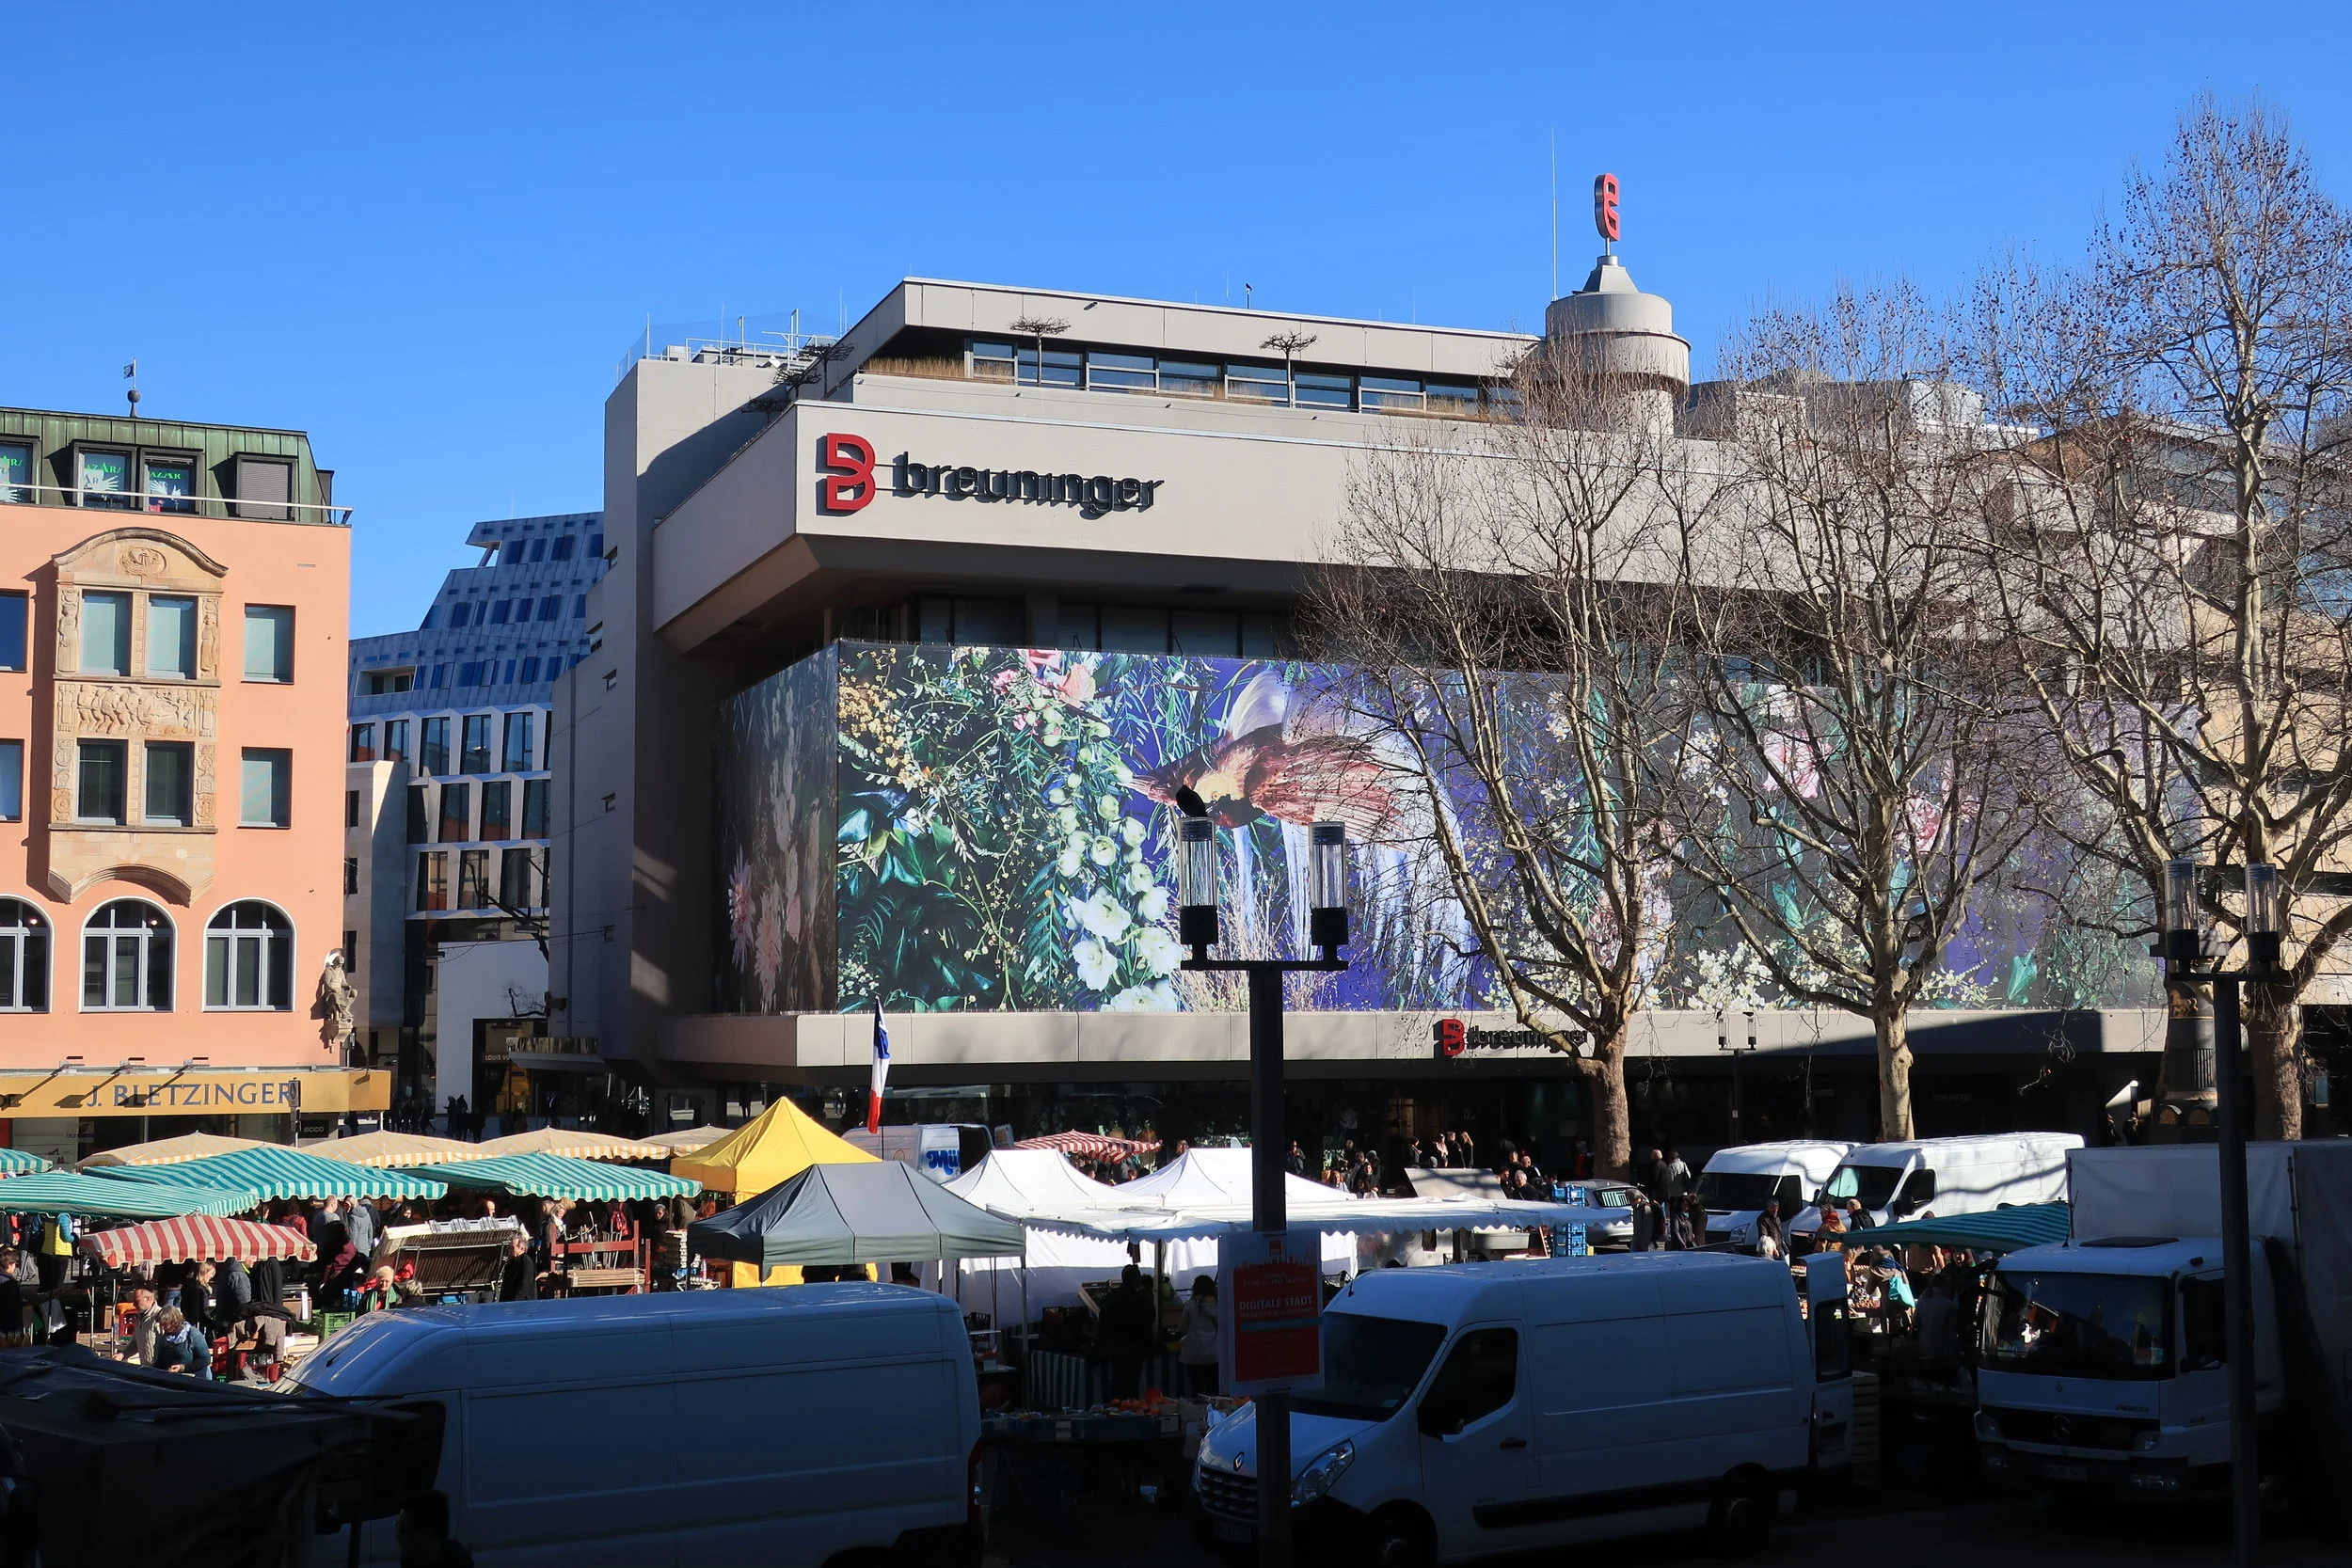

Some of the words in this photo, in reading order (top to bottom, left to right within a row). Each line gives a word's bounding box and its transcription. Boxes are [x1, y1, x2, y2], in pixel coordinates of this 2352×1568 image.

[902, 451, 1165, 515] breuninger
[87, 1085, 103, 1107] J.
[114, 1082, 292, 1107] BLETZINGER
[1239, 1298, 1281, 1311] DIGITALE
[1284, 1295, 1312, 1307] STADT
